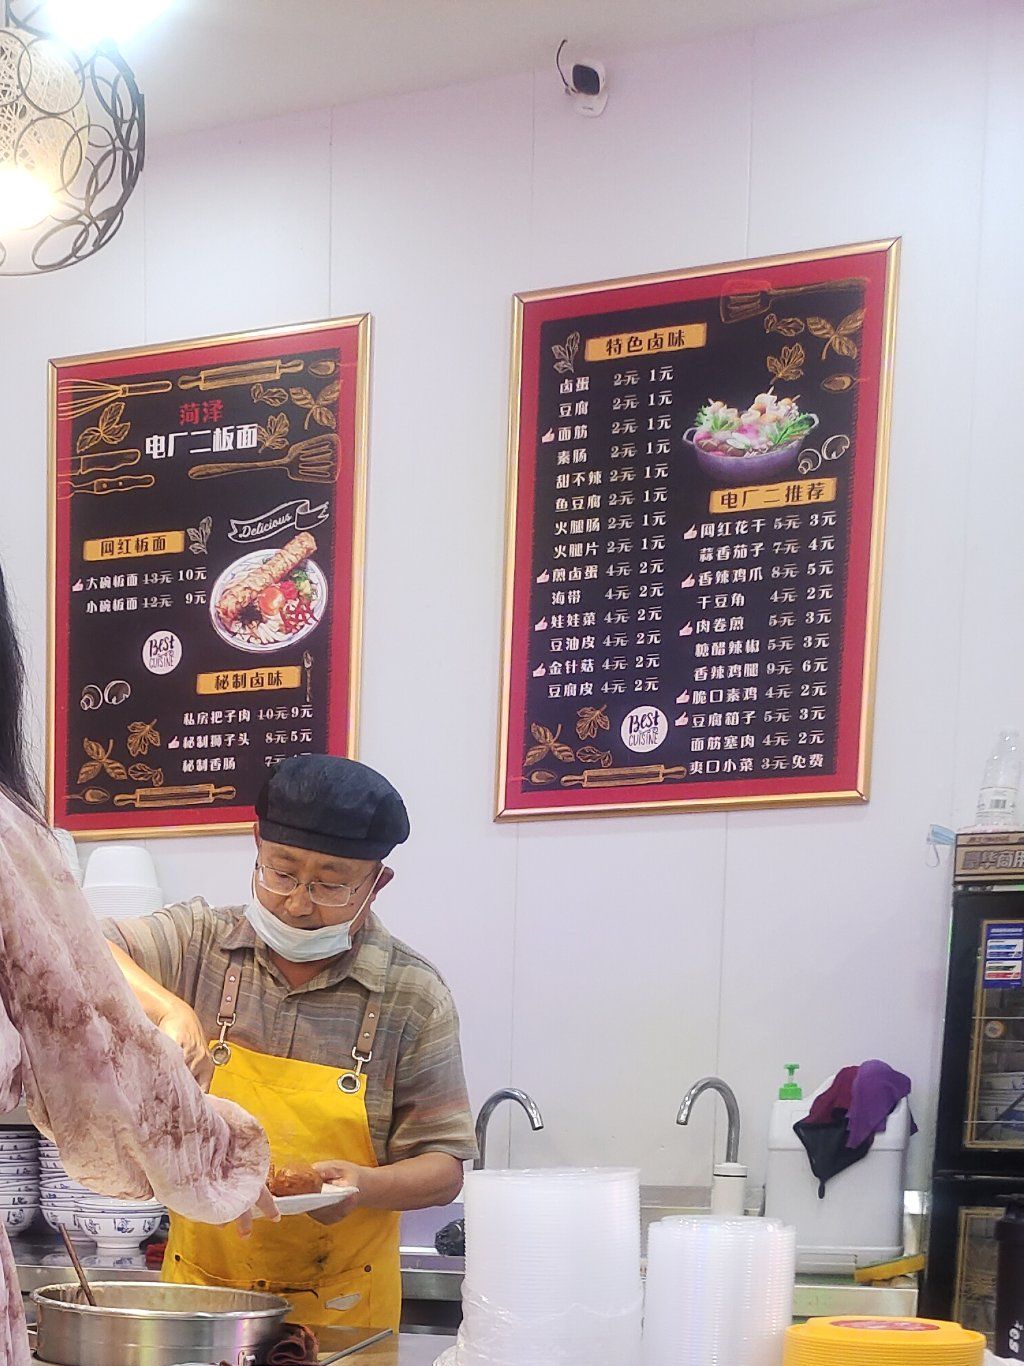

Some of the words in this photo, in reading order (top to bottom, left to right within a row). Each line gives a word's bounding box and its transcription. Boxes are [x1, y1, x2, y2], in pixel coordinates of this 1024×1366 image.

[606, 330, 686, 356] 特色卤味
[560, 377, 589, 394] 卤蛋
[614, 370, 640, 385] 2元
[650, 366, 673, 381] 1元
[179, 400, 223, 425] 菏泽
[559, 401, 588, 418] 豆腐
[613, 394, 640, 410] 2元
[648, 390, 672, 406] 1元
[558, 424, 587, 441] 面筋
[612, 419, 639, 434] 2元
[647, 415, 671, 430] 1元
[145, 424, 258, 459] 电厂二板面
[557, 448, 587, 465] 素肠
[611, 443, 637, 458] 2元
[646, 439, 670, 454] 1元
[556, 471, 602, 489] 甜不辣
[610, 467, 636, 482] 2元
[644, 463, 668, 478] 1元
[555, 494, 601, 512] 鱼豆腐
[609, 490, 635, 506] 2元
[643, 487, 667, 502] 1元
[720, 482, 825, 508] 电厂二推荐
[239, 512, 292, 538] Delicious
[554, 518, 600, 535] 火腿肠
[608, 515, 634, 529] 2元
[642, 511, 666, 526] 1元
[701, 519, 766, 538] 网红花干
[774, 515, 802, 530] 5元
[810, 511, 836, 526] 3元
[100, 536, 166, 555] 网红板面
[554, 542, 599, 558] 火腿片
[607, 538, 633, 553] 2元
[641, 535, 666, 550] 1元
[699, 542, 764, 562] 蒜香茄子
[773, 539, 800, 554] 7元
[808, 536, 834, 551] 4元
[86, 573, 138, 590] 大碗板面
[143, 571, 173, 584] 13元
[178, 567, 207, 581] 10元
[553, 565, 598, 582] 煎卤蛋
[606, 562, 632, 576] 4元
[639, 559, 664, 574] 2元
[698, 567, 763, 586] 香辣鸡爪
[772, 564, 799, 579] 8元
[807, 560, 834, 575] 5元
[86, 597, 138, 613] 小碗板面
[142, 594, 173, 608] 12元
[186, 591, 206, 604] 9元
[552, 590, 581, 605] 海带
[605, 586, 631, 600] 4元
[639, 583, 664, 597] 2元
[697, 593, 744, 609] 干豆角
[770, 588, 798, 602] 4元
[807, 584, 833, 600] 2元
[551, 612, 596, 628] 娃娃菜
[604, 609, 630, 624] 4元
[638, 606, 662, 621] 2元
[769, 612, 796, 627] 5元
[806, 609, 832, 624] 3元
[149, 634, 174, 657] Best
[550, 636, 595, 652] 豆油皮
[603, 633, 629, 647] 4元
[636, 630, 661, 644] 2元
[695, 639, 759, 658] 糖醋辣椒
[768, 636, 795, 651] 5元
[803, 633, 829, 648] 3元
[149, 656, 174, 669] CUISINE
[549, 659, 594, 675] 金针菇
[602, 657, 628, 670] 4元
[636, 654, 660, 668] 2元
[694, 663, 758, 682] 香辣鸡腿
[767, 660, 794, 675] 9元
[802, 658, 828, 672] 6元
[215, 671, 283, 690] 秘制卤味
[548, 682, 593, 698] 豆腐皮
[601, 680, 627, 693] 4元
[634, 677, 658, 691] 2元
[692, 687, 757, 705] 脆口素鸡
[765, 684, 792, 699] 4元
[801, 682, 827, 696] 2元
[184, 709, 250, 725] 私房把子肉
[258, 706, 288, 720] 10元
[291, 705, 312, 718] 9元
[628, 710, 660, 734] Best
[692, 711, 756, 728] 豆腐箱子
[764, 708, 791, 722] 5元
[800, 706, 825, 720] 3元
[183, 733, 249, 748] 秘制狮子头
[265, 731, 288, 743] 8元
[291, 729, 312, 742] 5元
[628, 734, 658, 746] CUISINE
[691, 734, 755, 751] 面筋塞肉
[763, 732, 790, 746] 4元
[798, 730, 824, 744] 2元
[182, 757, 235, 772] 秘制香肠
[690, 758, 754, 775] 爽口小菜
[762, 756, 789, 770] 3元
[792, 754, 824, 769] 免费
